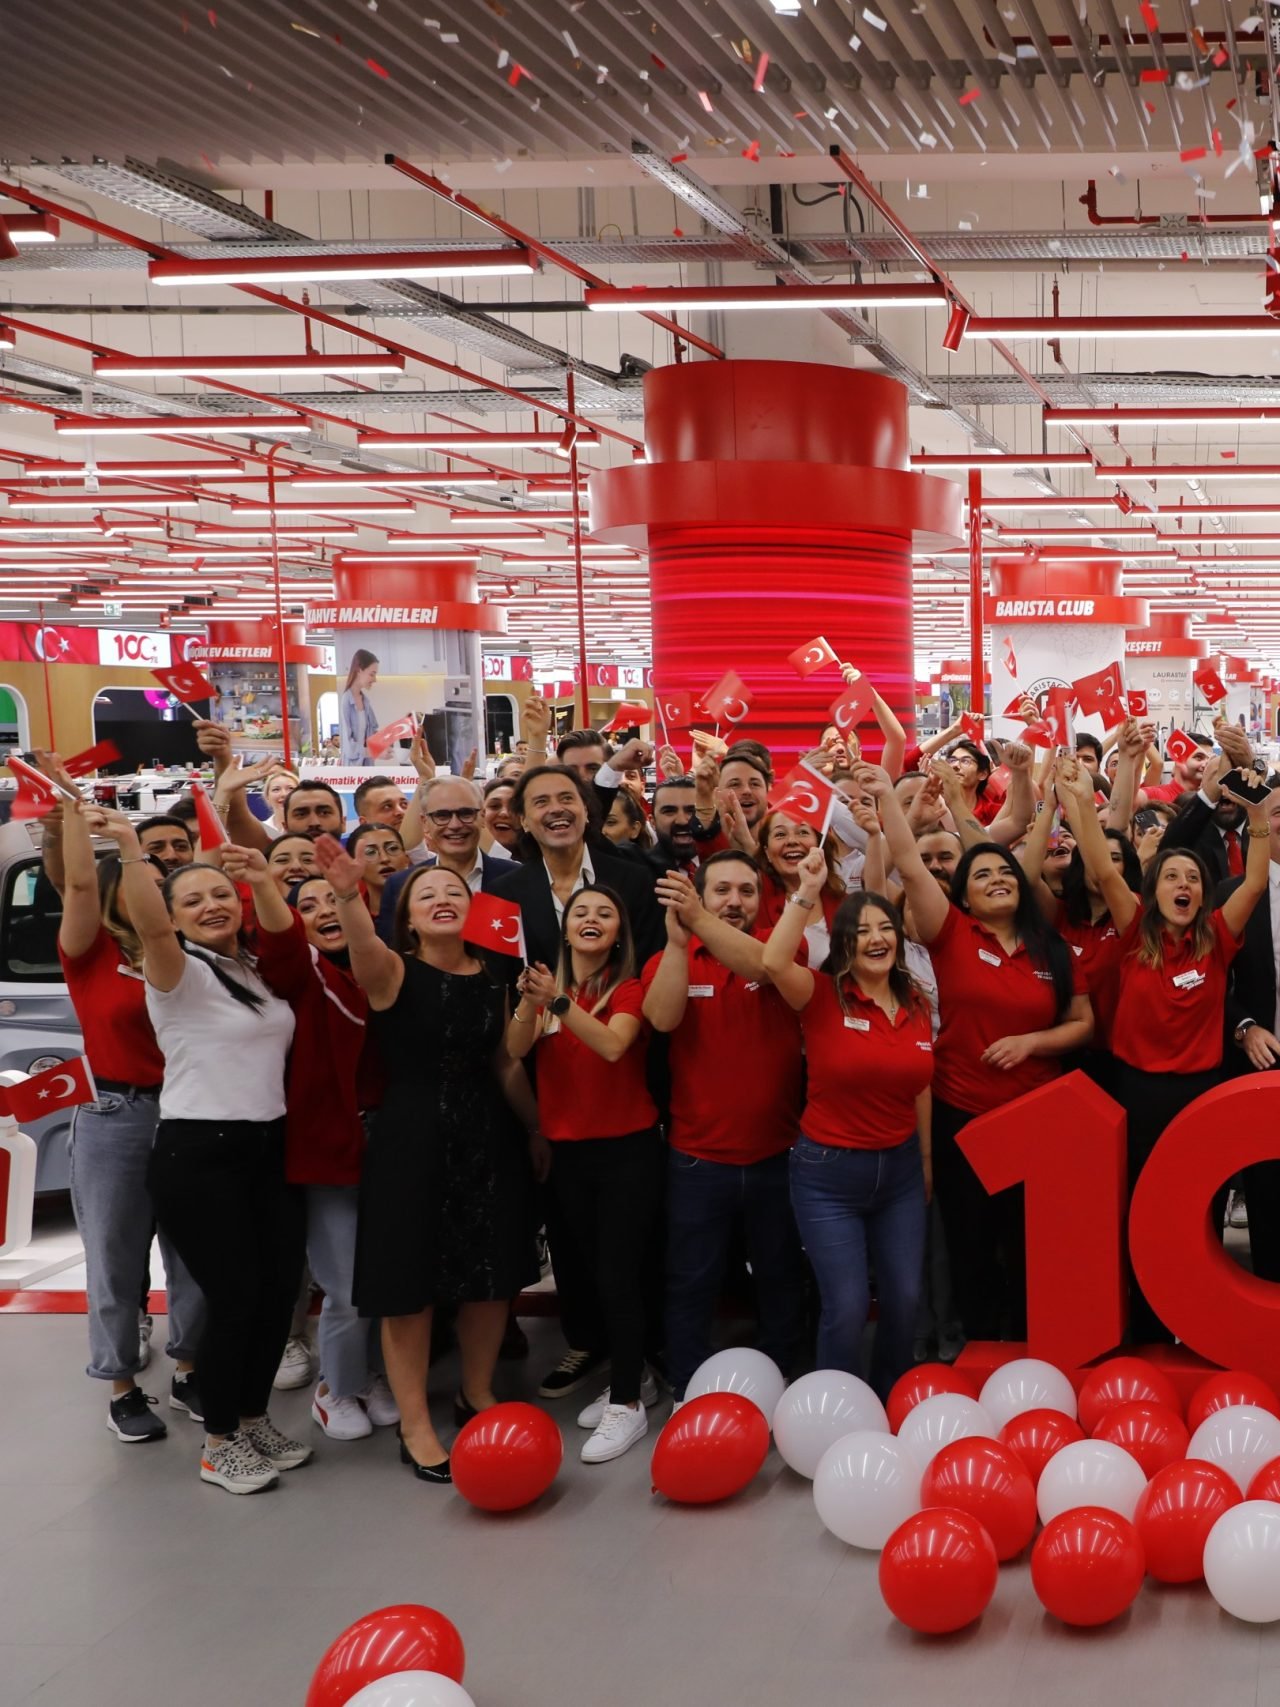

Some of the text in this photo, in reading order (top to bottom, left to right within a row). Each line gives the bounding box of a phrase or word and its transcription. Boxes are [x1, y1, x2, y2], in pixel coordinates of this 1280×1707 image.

[307, 605, 439, 624] KAHVE MAKİNELERİ
[996, 600, 1095, 617] BARISTA CLUB
[209, 646, 222, 658] EV
[221, 646, 273, 658] ALETLERİ
[1126, 641, 1162, 655] KEŞFET!
